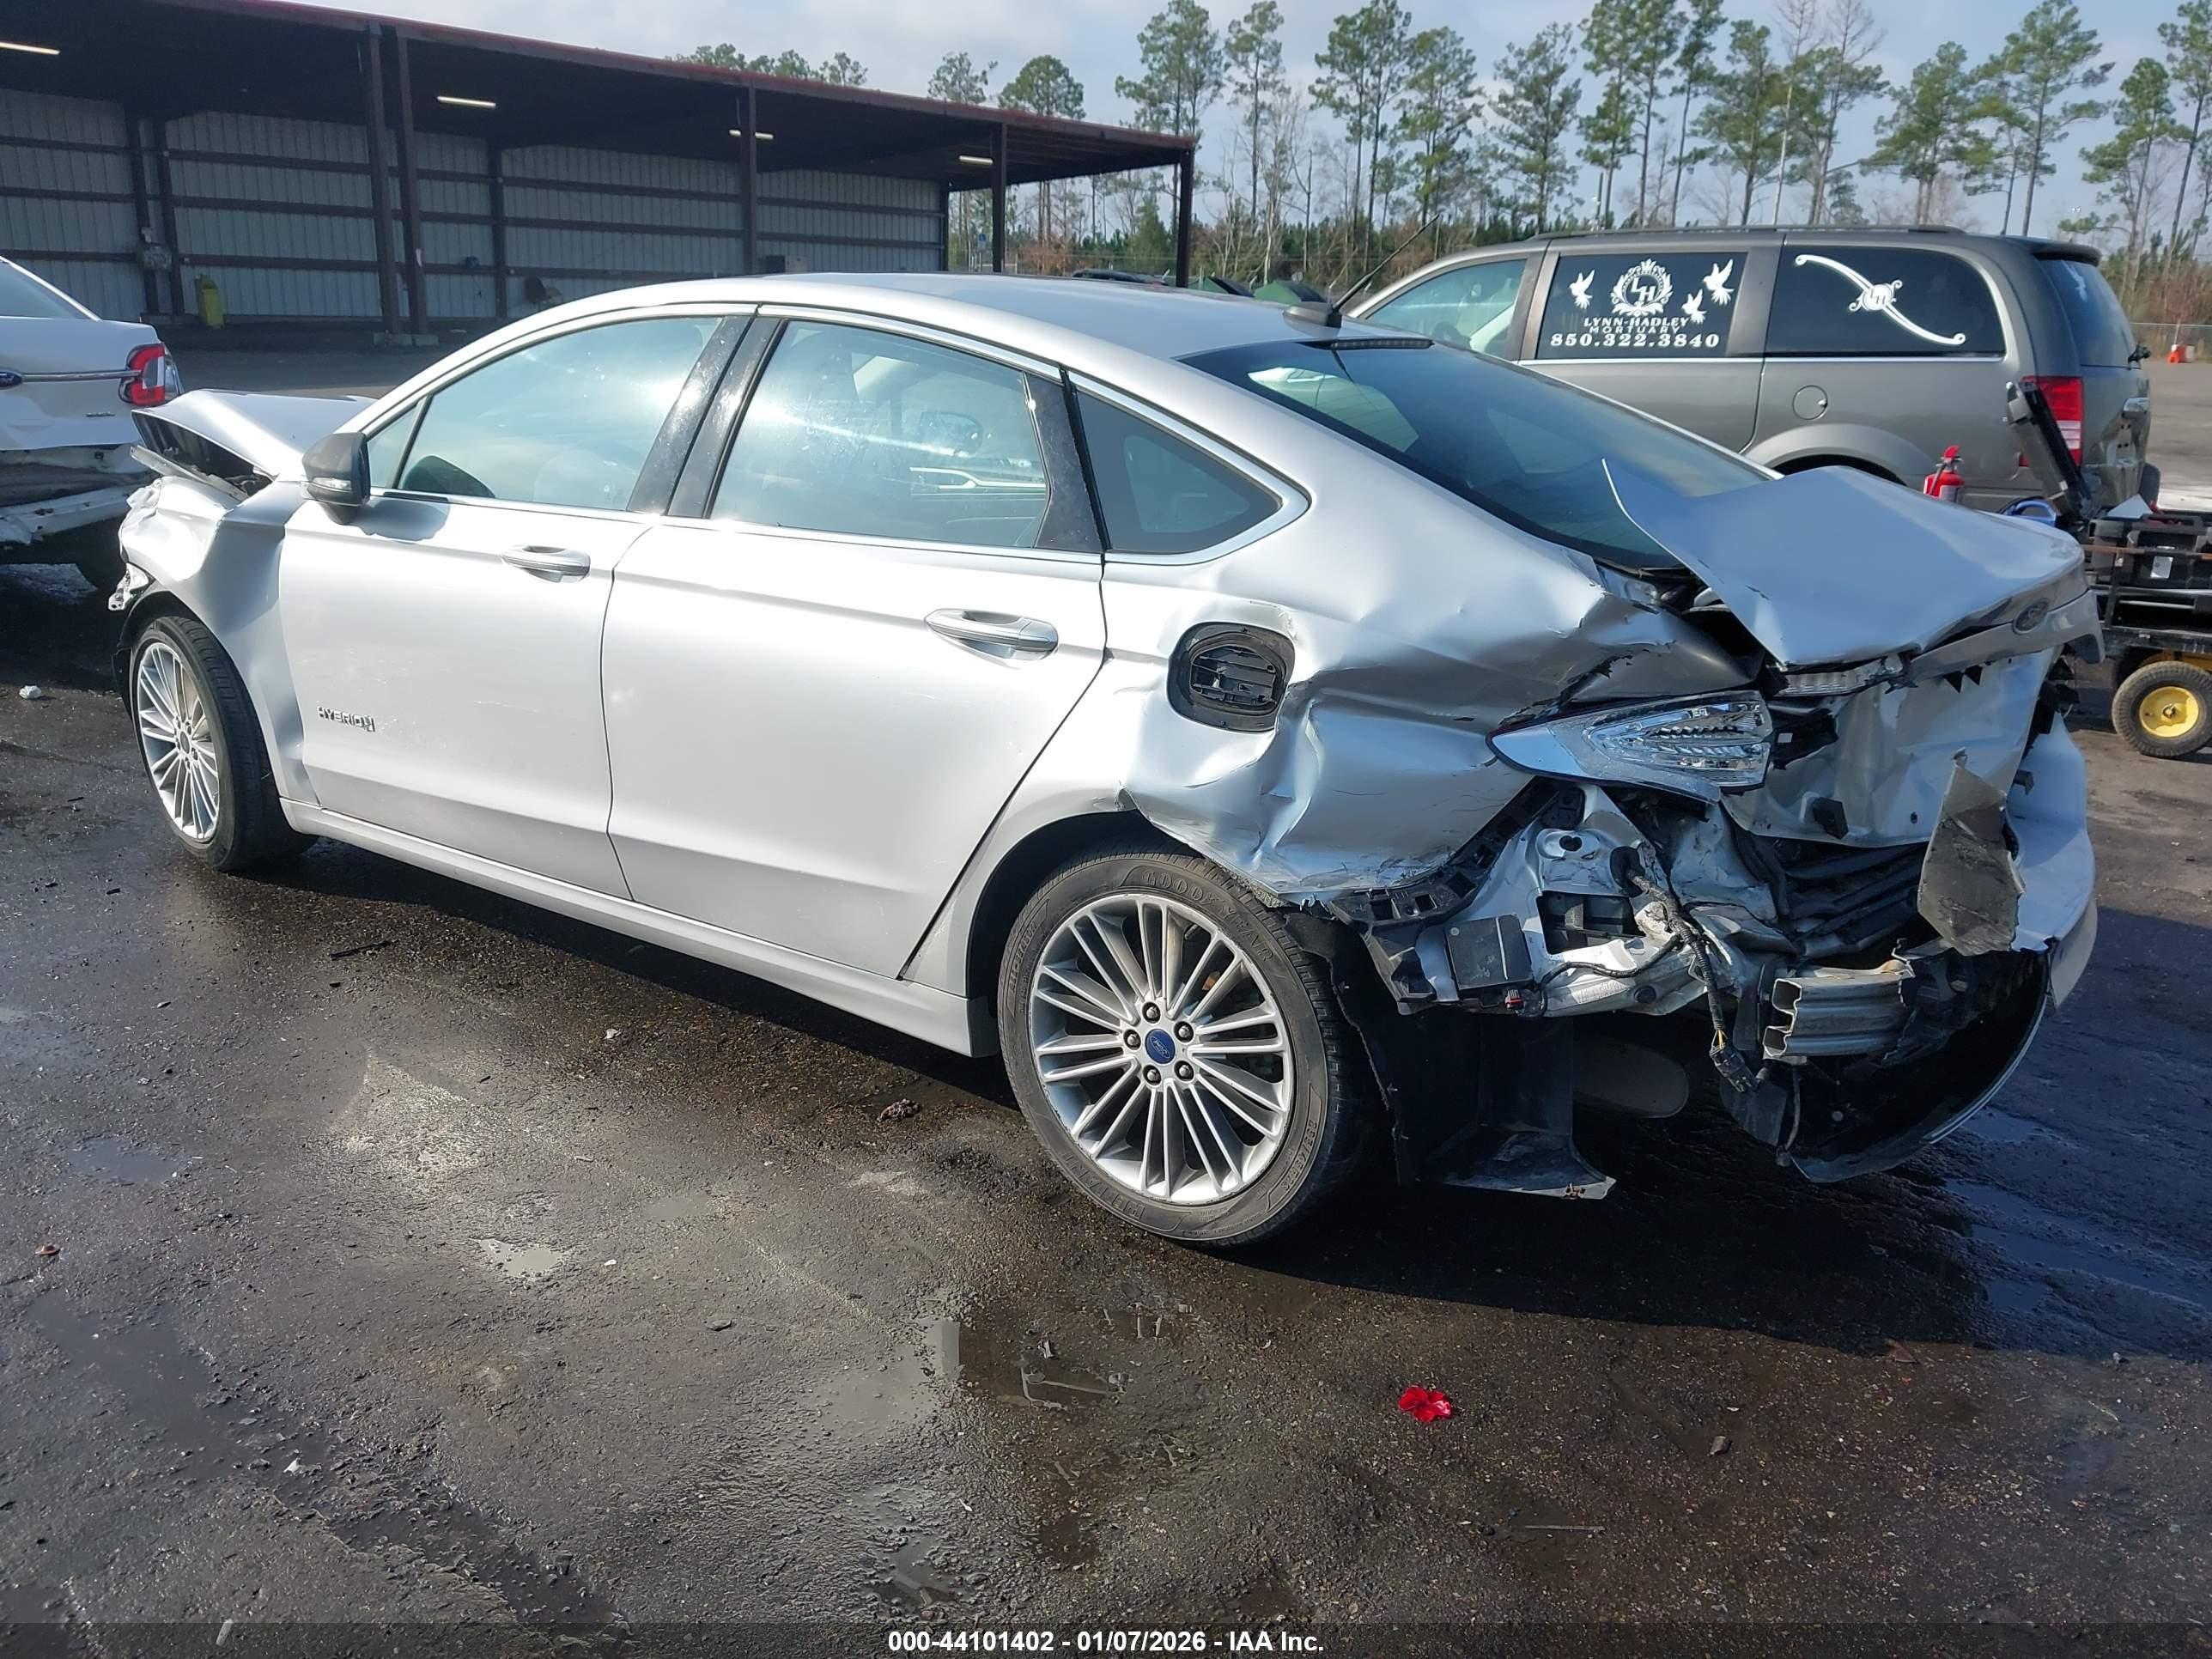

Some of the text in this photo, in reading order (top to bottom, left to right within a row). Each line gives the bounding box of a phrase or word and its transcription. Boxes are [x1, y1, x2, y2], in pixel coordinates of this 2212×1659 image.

[1631, 276, 1656, 301] LH
[1583, 317, 1690, 328] LYNN-HADLEY
[1589, 326, 1681, 335] MORTUARY
[1550, 333, 1720, 348] 850.322.3840
